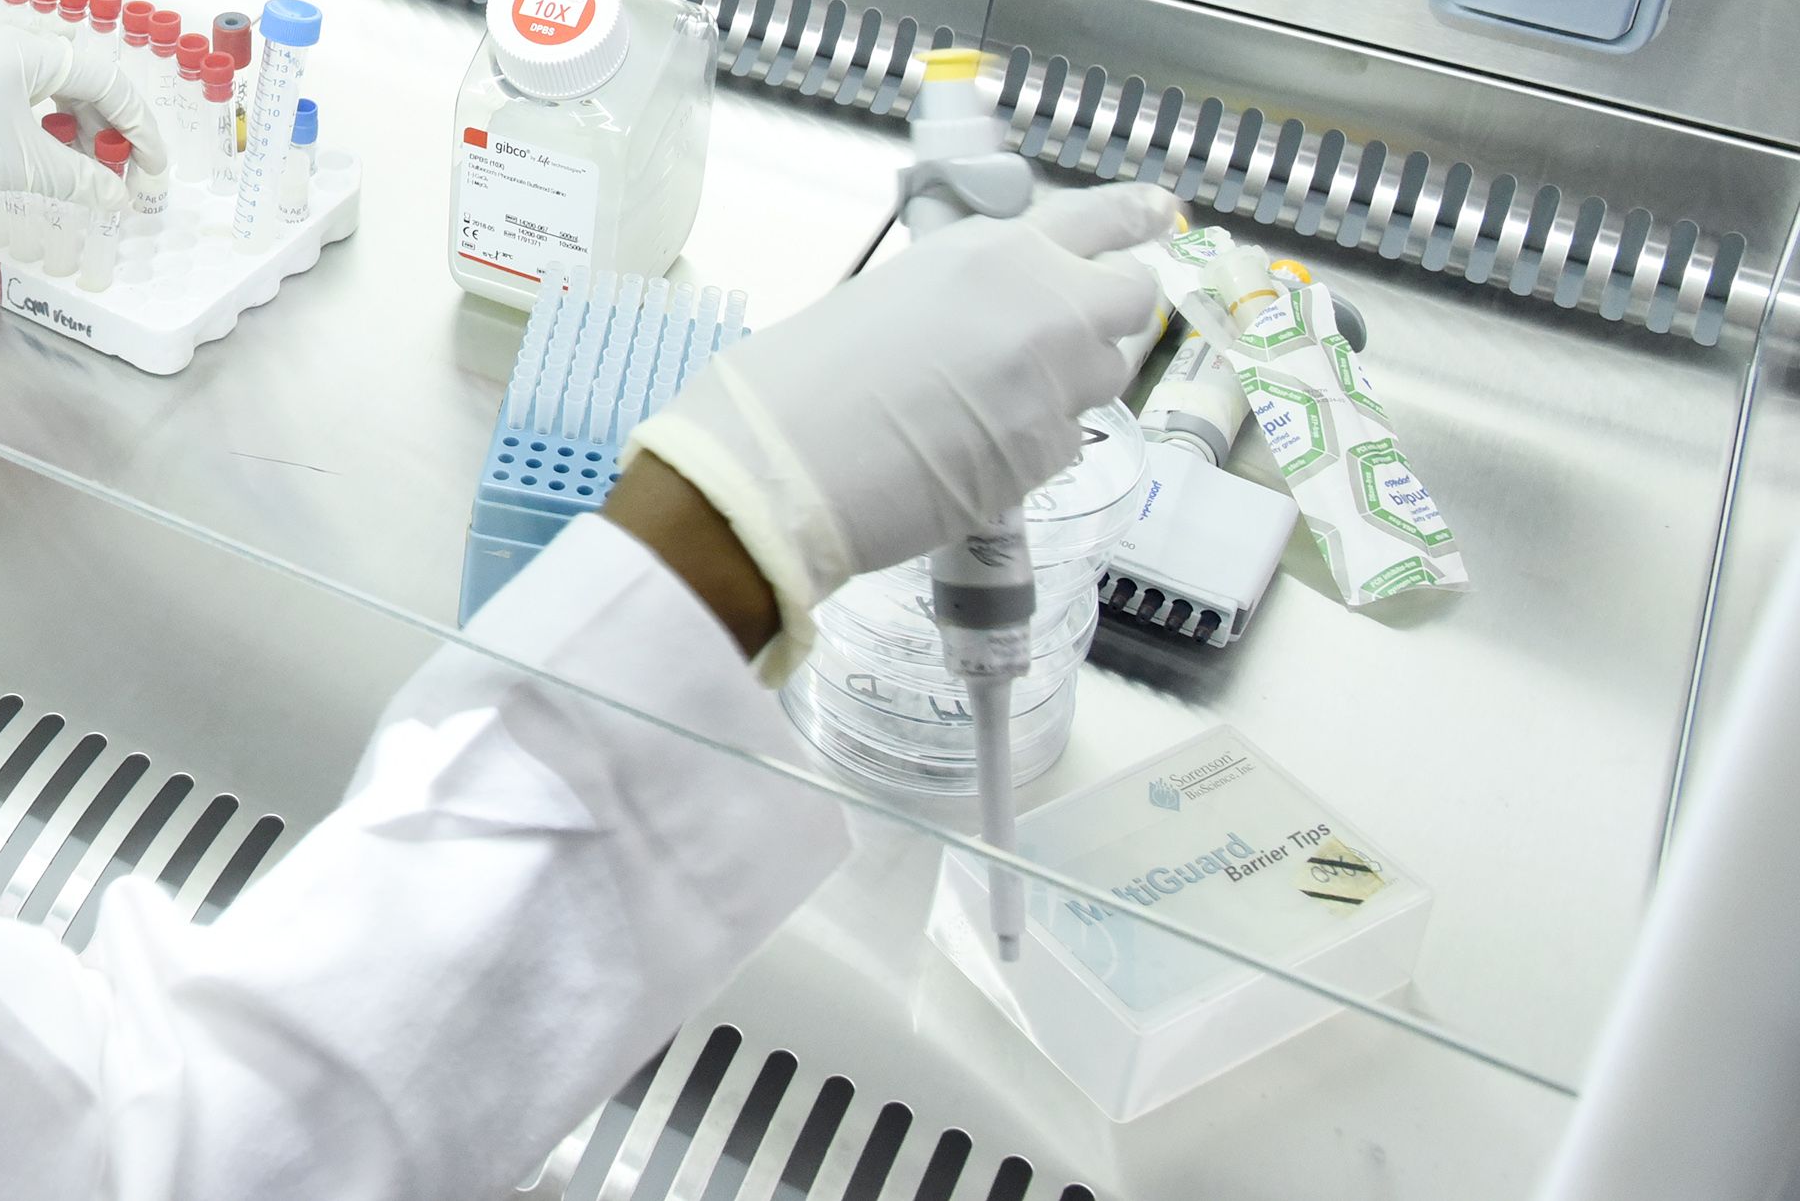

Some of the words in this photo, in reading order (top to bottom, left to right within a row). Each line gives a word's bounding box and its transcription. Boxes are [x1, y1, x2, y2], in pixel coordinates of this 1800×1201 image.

[535, 0, 571, 22] 10X
[529, 22, 555, 36] DPBS
[272, 79, 286, 88] 12
[266, 108, 280, 117] 10
[263, 123, 271, 132] 9
[261, 138, 269, 147] 8
[495, 141, 527, 158] gibco
[255, 168, 263, 177] 6
[252, 183, 260, 192] 5
[1169, 753, 1234, 788] Sorenson
[1224, 845, 1289, 883] Barrier
[1287, 822, 1331, 849] Tips
[1064, 831, 1257, 927] MltiGuard
